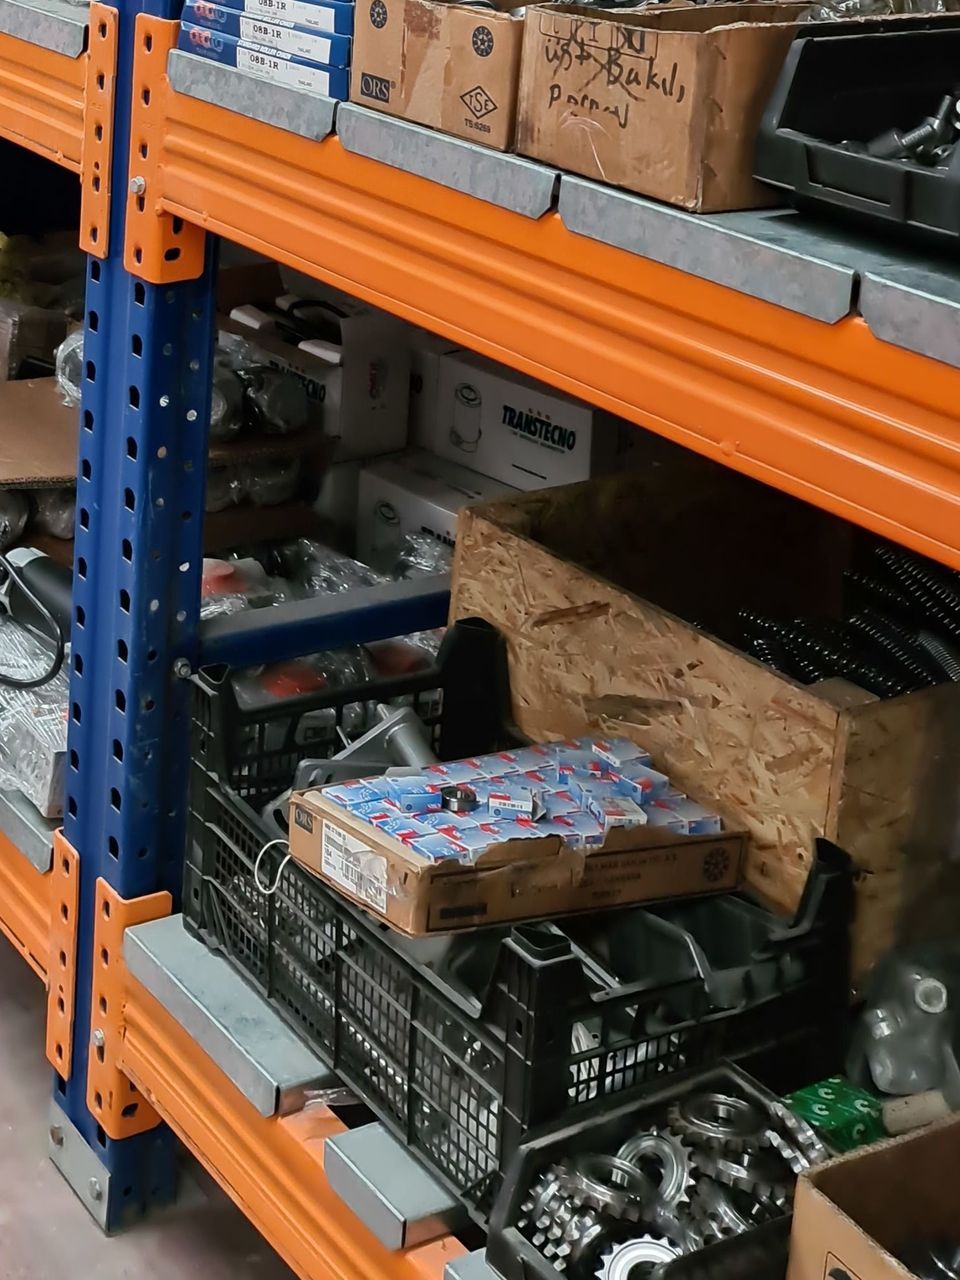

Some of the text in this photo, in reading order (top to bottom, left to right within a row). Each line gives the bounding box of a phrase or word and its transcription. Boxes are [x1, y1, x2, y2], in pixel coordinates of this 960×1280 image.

[253, 24, 282, 39] 08B-1R
[249, 54, 279, 70] 08B-1R
[362, 75, 389, 100] ORS
[468, 91, 489, 113] TSE
[502, 405, 576, 451] TRANSTECNO
